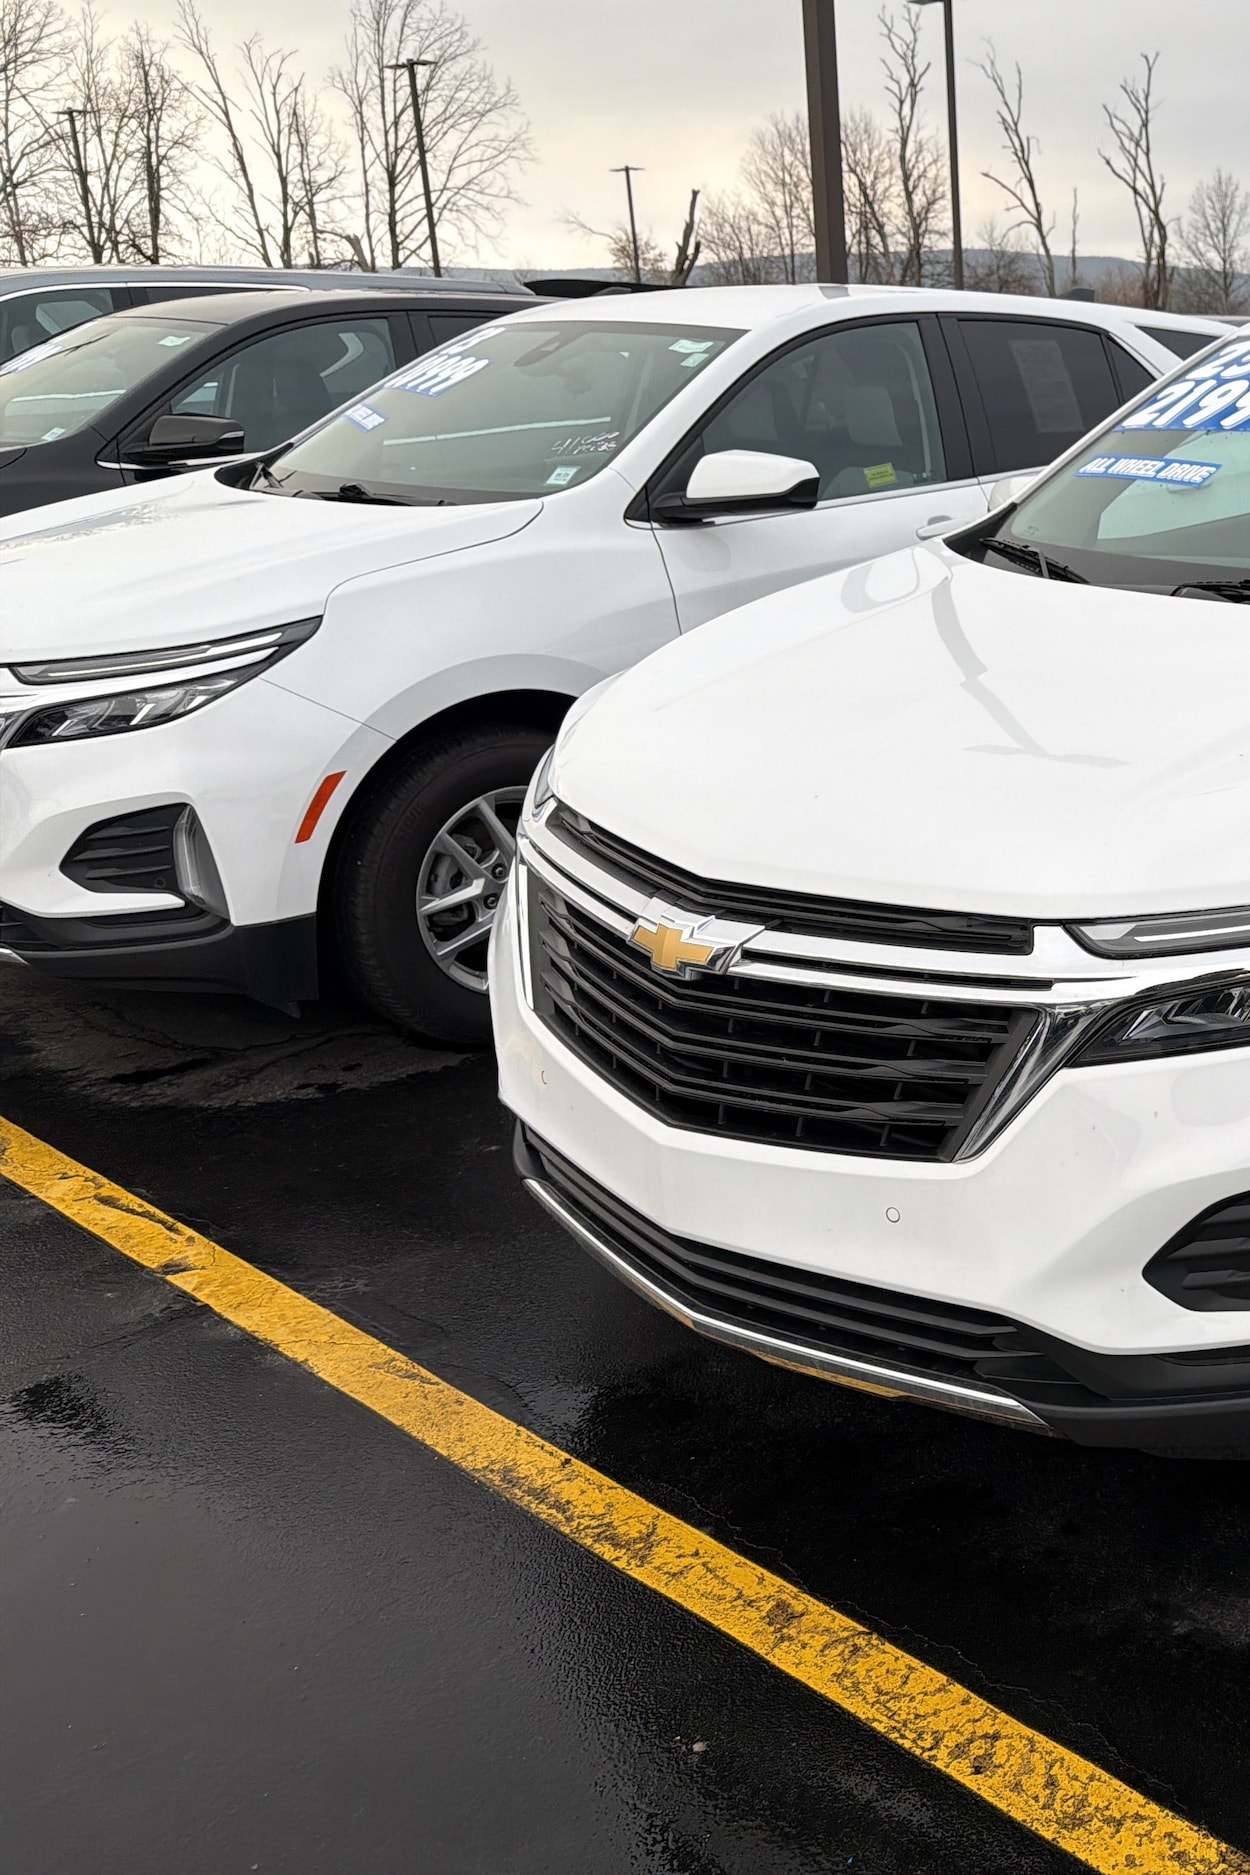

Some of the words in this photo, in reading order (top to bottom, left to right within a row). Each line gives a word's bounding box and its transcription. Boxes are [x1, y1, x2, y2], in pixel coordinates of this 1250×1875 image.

[1078, 457, 1116, 474] ALL
[1107, 458, 1166, 478] WHEEL
[1155, 462, 1217, 484] DRIVE
